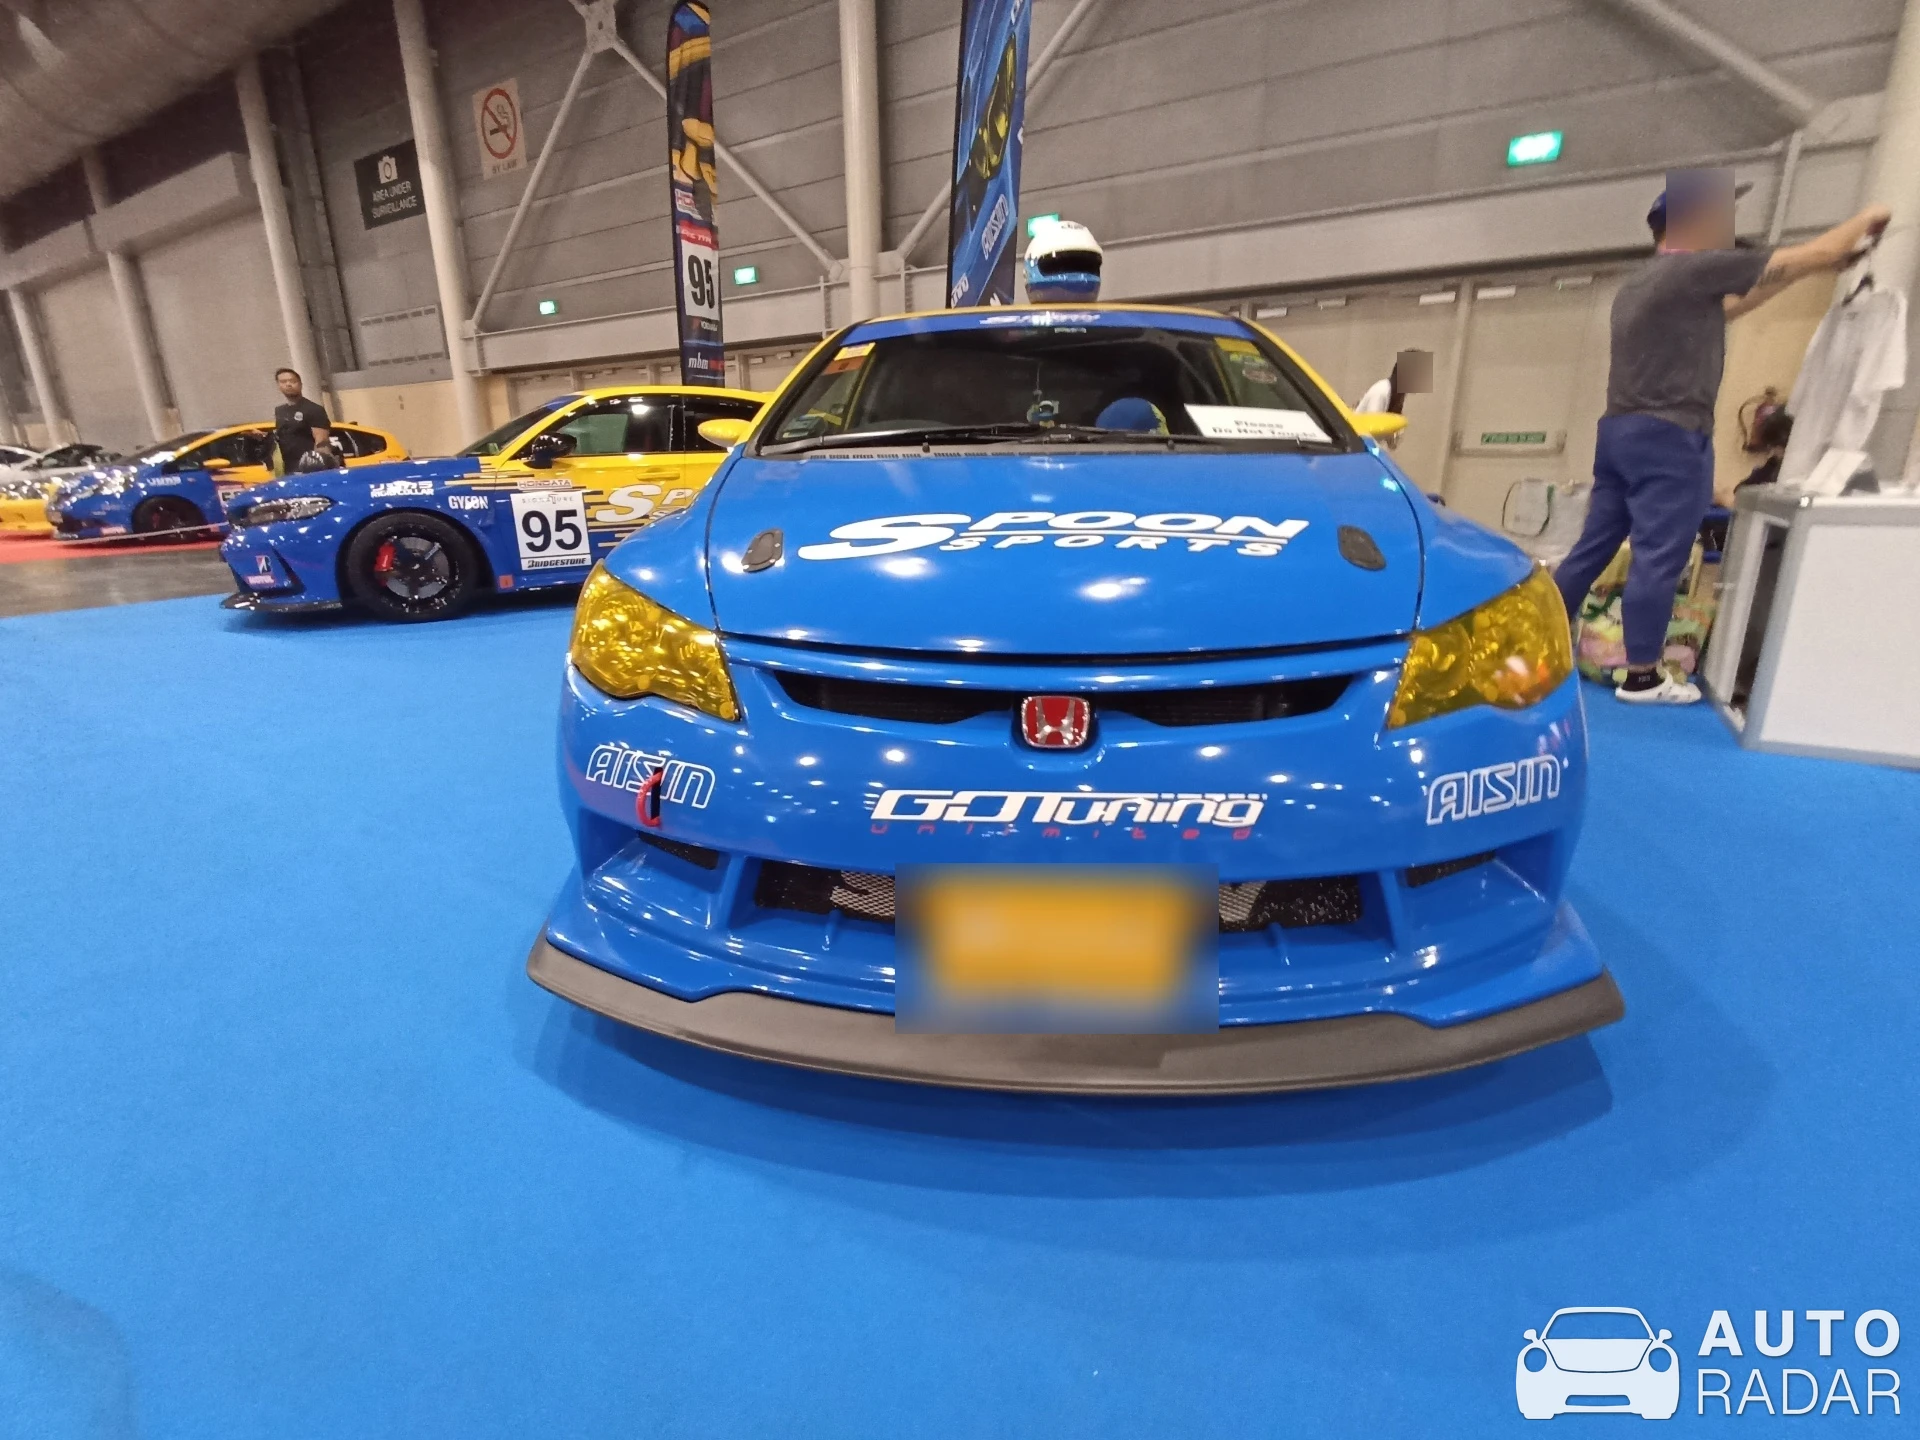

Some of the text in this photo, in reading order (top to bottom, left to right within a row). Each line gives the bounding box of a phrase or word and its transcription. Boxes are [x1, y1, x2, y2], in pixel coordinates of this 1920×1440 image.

[503, 159, 518, 171] LAW
[373, 181, 412, 202] AREA UNDER
[687, 254, 715, 309] 95
[519, 480, 572, 489] HONDATA
[521, 509, 582, 553] 95
[798, 511, 1309, 560] SPOON
[940, 534, 1283, 557] SPORTS
[527, 558, 587, 569] BRIDGESTONE
[585, 744, 716, 809] AISIN
[1426, 754, 1561, 826] AISIN
